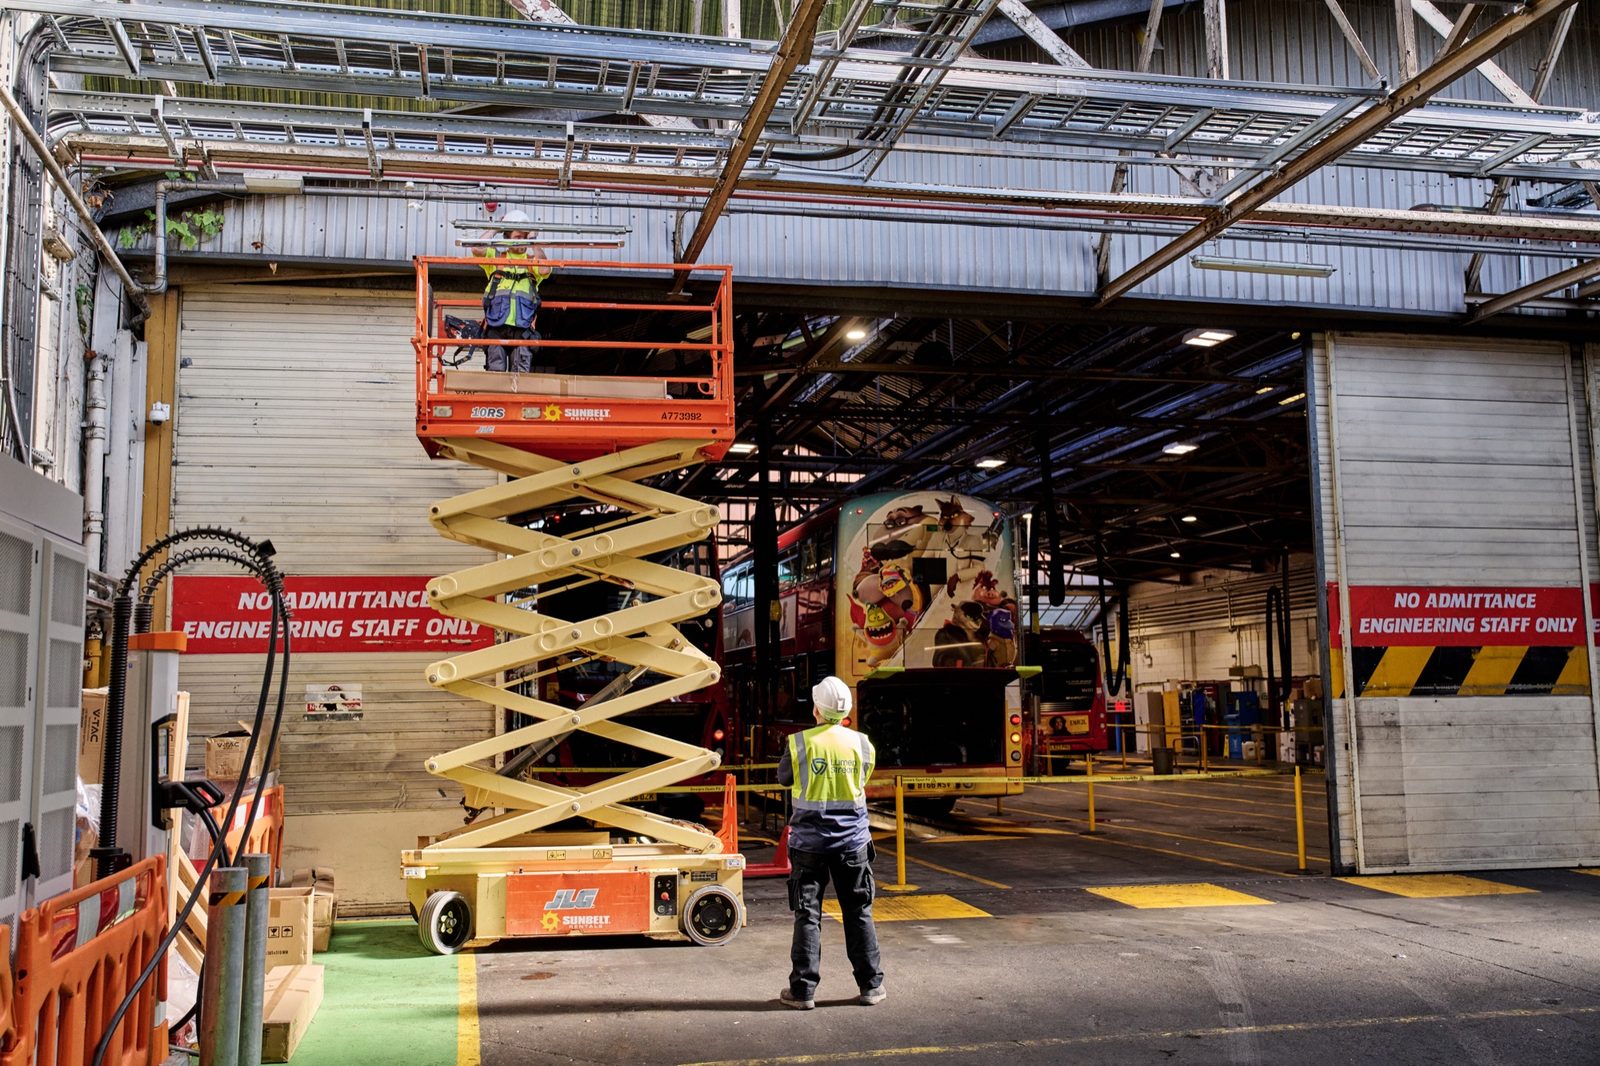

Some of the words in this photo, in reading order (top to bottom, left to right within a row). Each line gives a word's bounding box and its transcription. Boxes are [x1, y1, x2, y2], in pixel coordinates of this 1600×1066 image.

[471, 407, 505, 419] 10RS
[564, 408, 610, 418] SUNBELT
[661, 411, 702, 421] A773992
[238, 592, 273, 610] NO
[1394, 592, 1420, 608] NO
[1425, 593, 1537, 609] ADMITTANCE
[350, 618, 420, 637] STAFF
[425, 618, 481, 636] ONLY
[1359, 617, 1475, 634] ENGINEERING
[1480, 617, 1531, 633] STAFF
[1535, 617, 1577, 633] ONLY
[90, 708, 101, 743] V-TAC
[544, 888, 599, 910] JLG
[562, 915, 611, 925] SUNBELT
